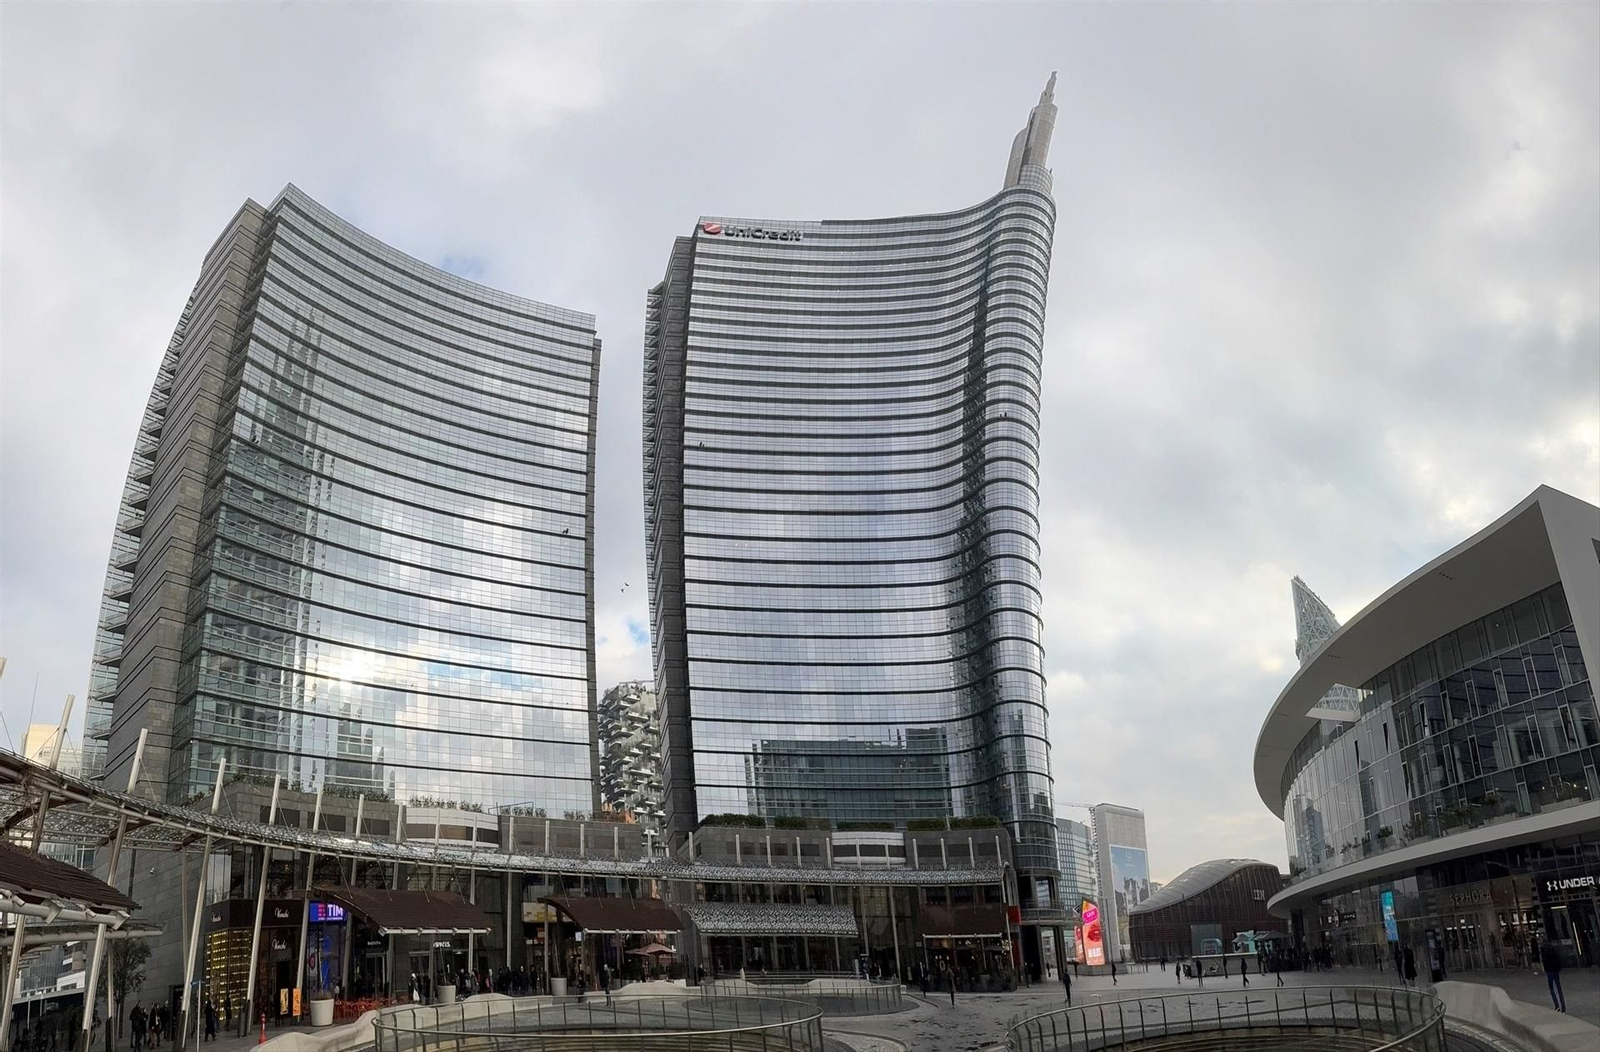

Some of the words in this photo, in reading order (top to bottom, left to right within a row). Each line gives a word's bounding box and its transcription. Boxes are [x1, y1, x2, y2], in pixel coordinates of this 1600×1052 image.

[724, 225, 801, 241] UniCredit
[1558, 876, 1595, 889] UNDER
[1253, 889, 1265, 901] IBM
[1449, 889, 1492, 906] SEPHORA
[327, 904, 344, 917] TIM
